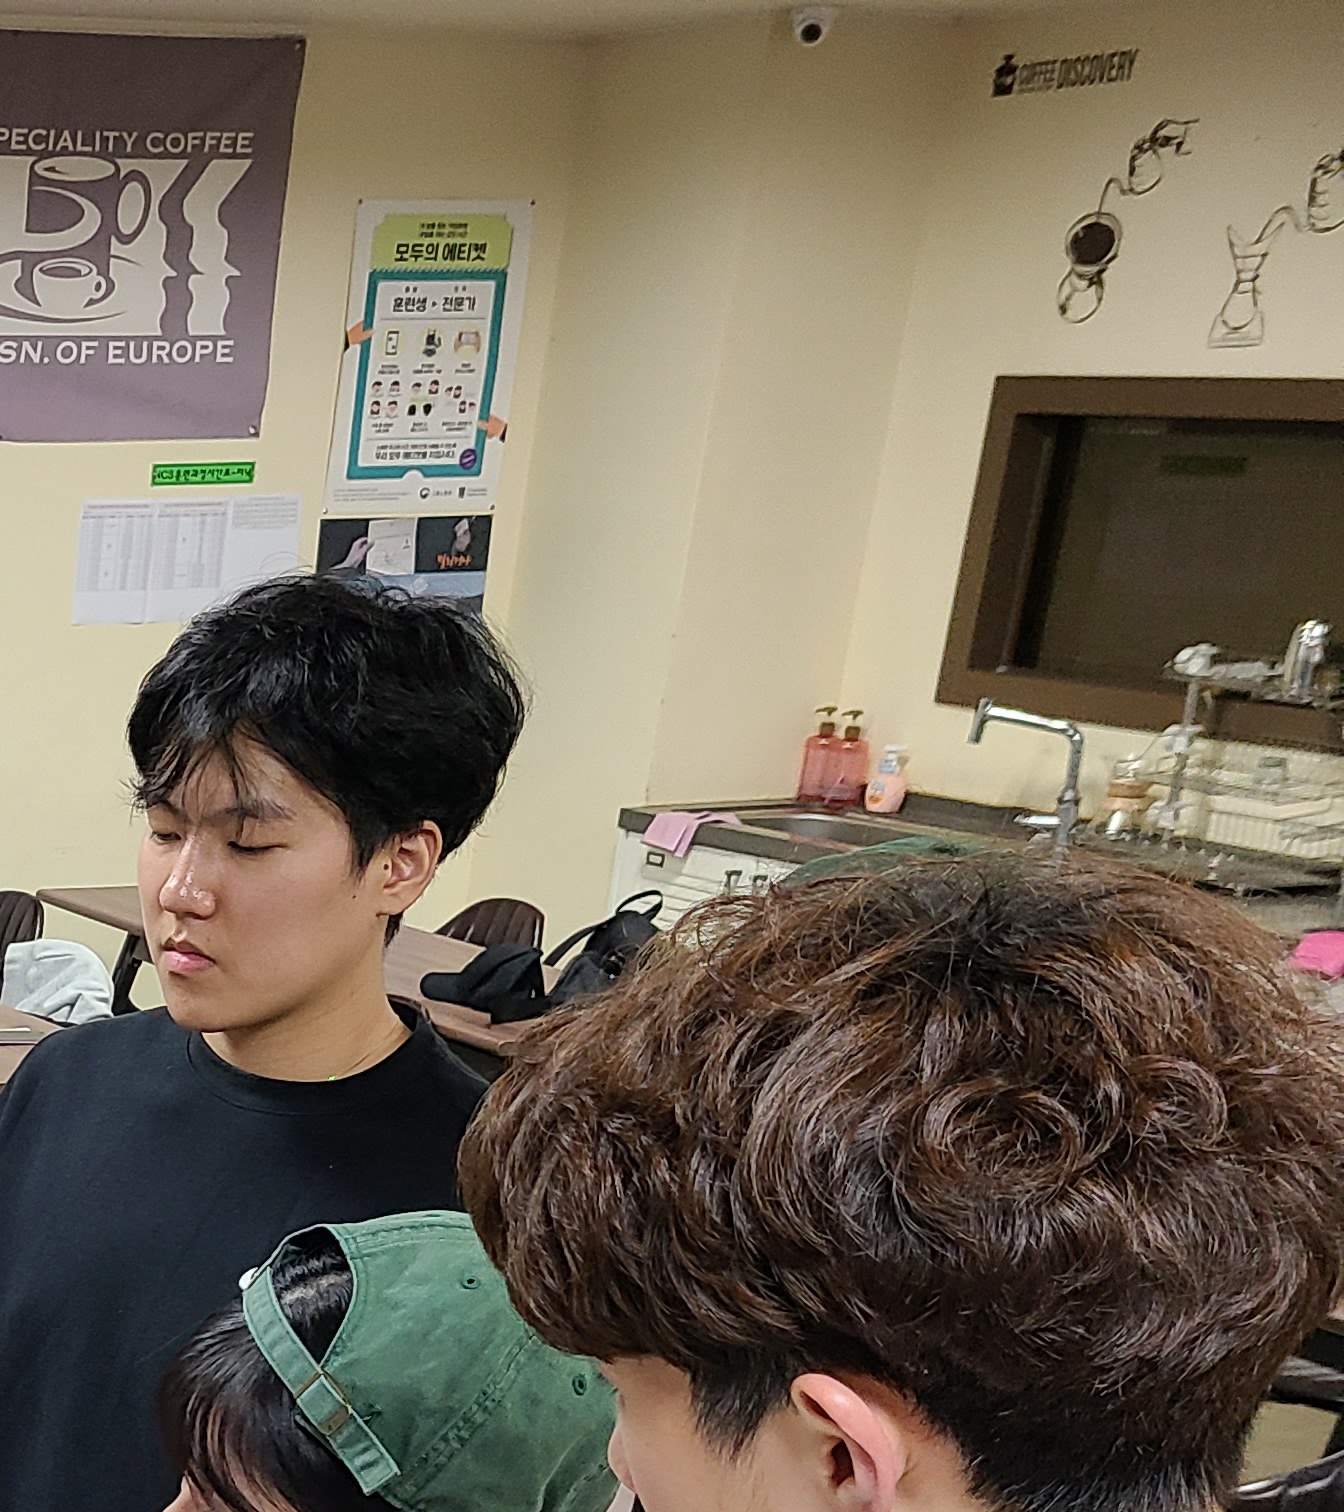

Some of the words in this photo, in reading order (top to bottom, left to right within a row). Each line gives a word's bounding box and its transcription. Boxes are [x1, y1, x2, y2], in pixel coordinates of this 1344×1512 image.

[1056, 48, 1139, 90] DISCOVERY
[145, 131, 254, 153] COFFEE
[394, 242, 439, 262] 모두의
[442, 242, 487, 262] 에티켓
[442, 296, 476, 313] 전문가
[55, 340, 99, 364] OF
[107, 340, 234, 364] EUROPE
